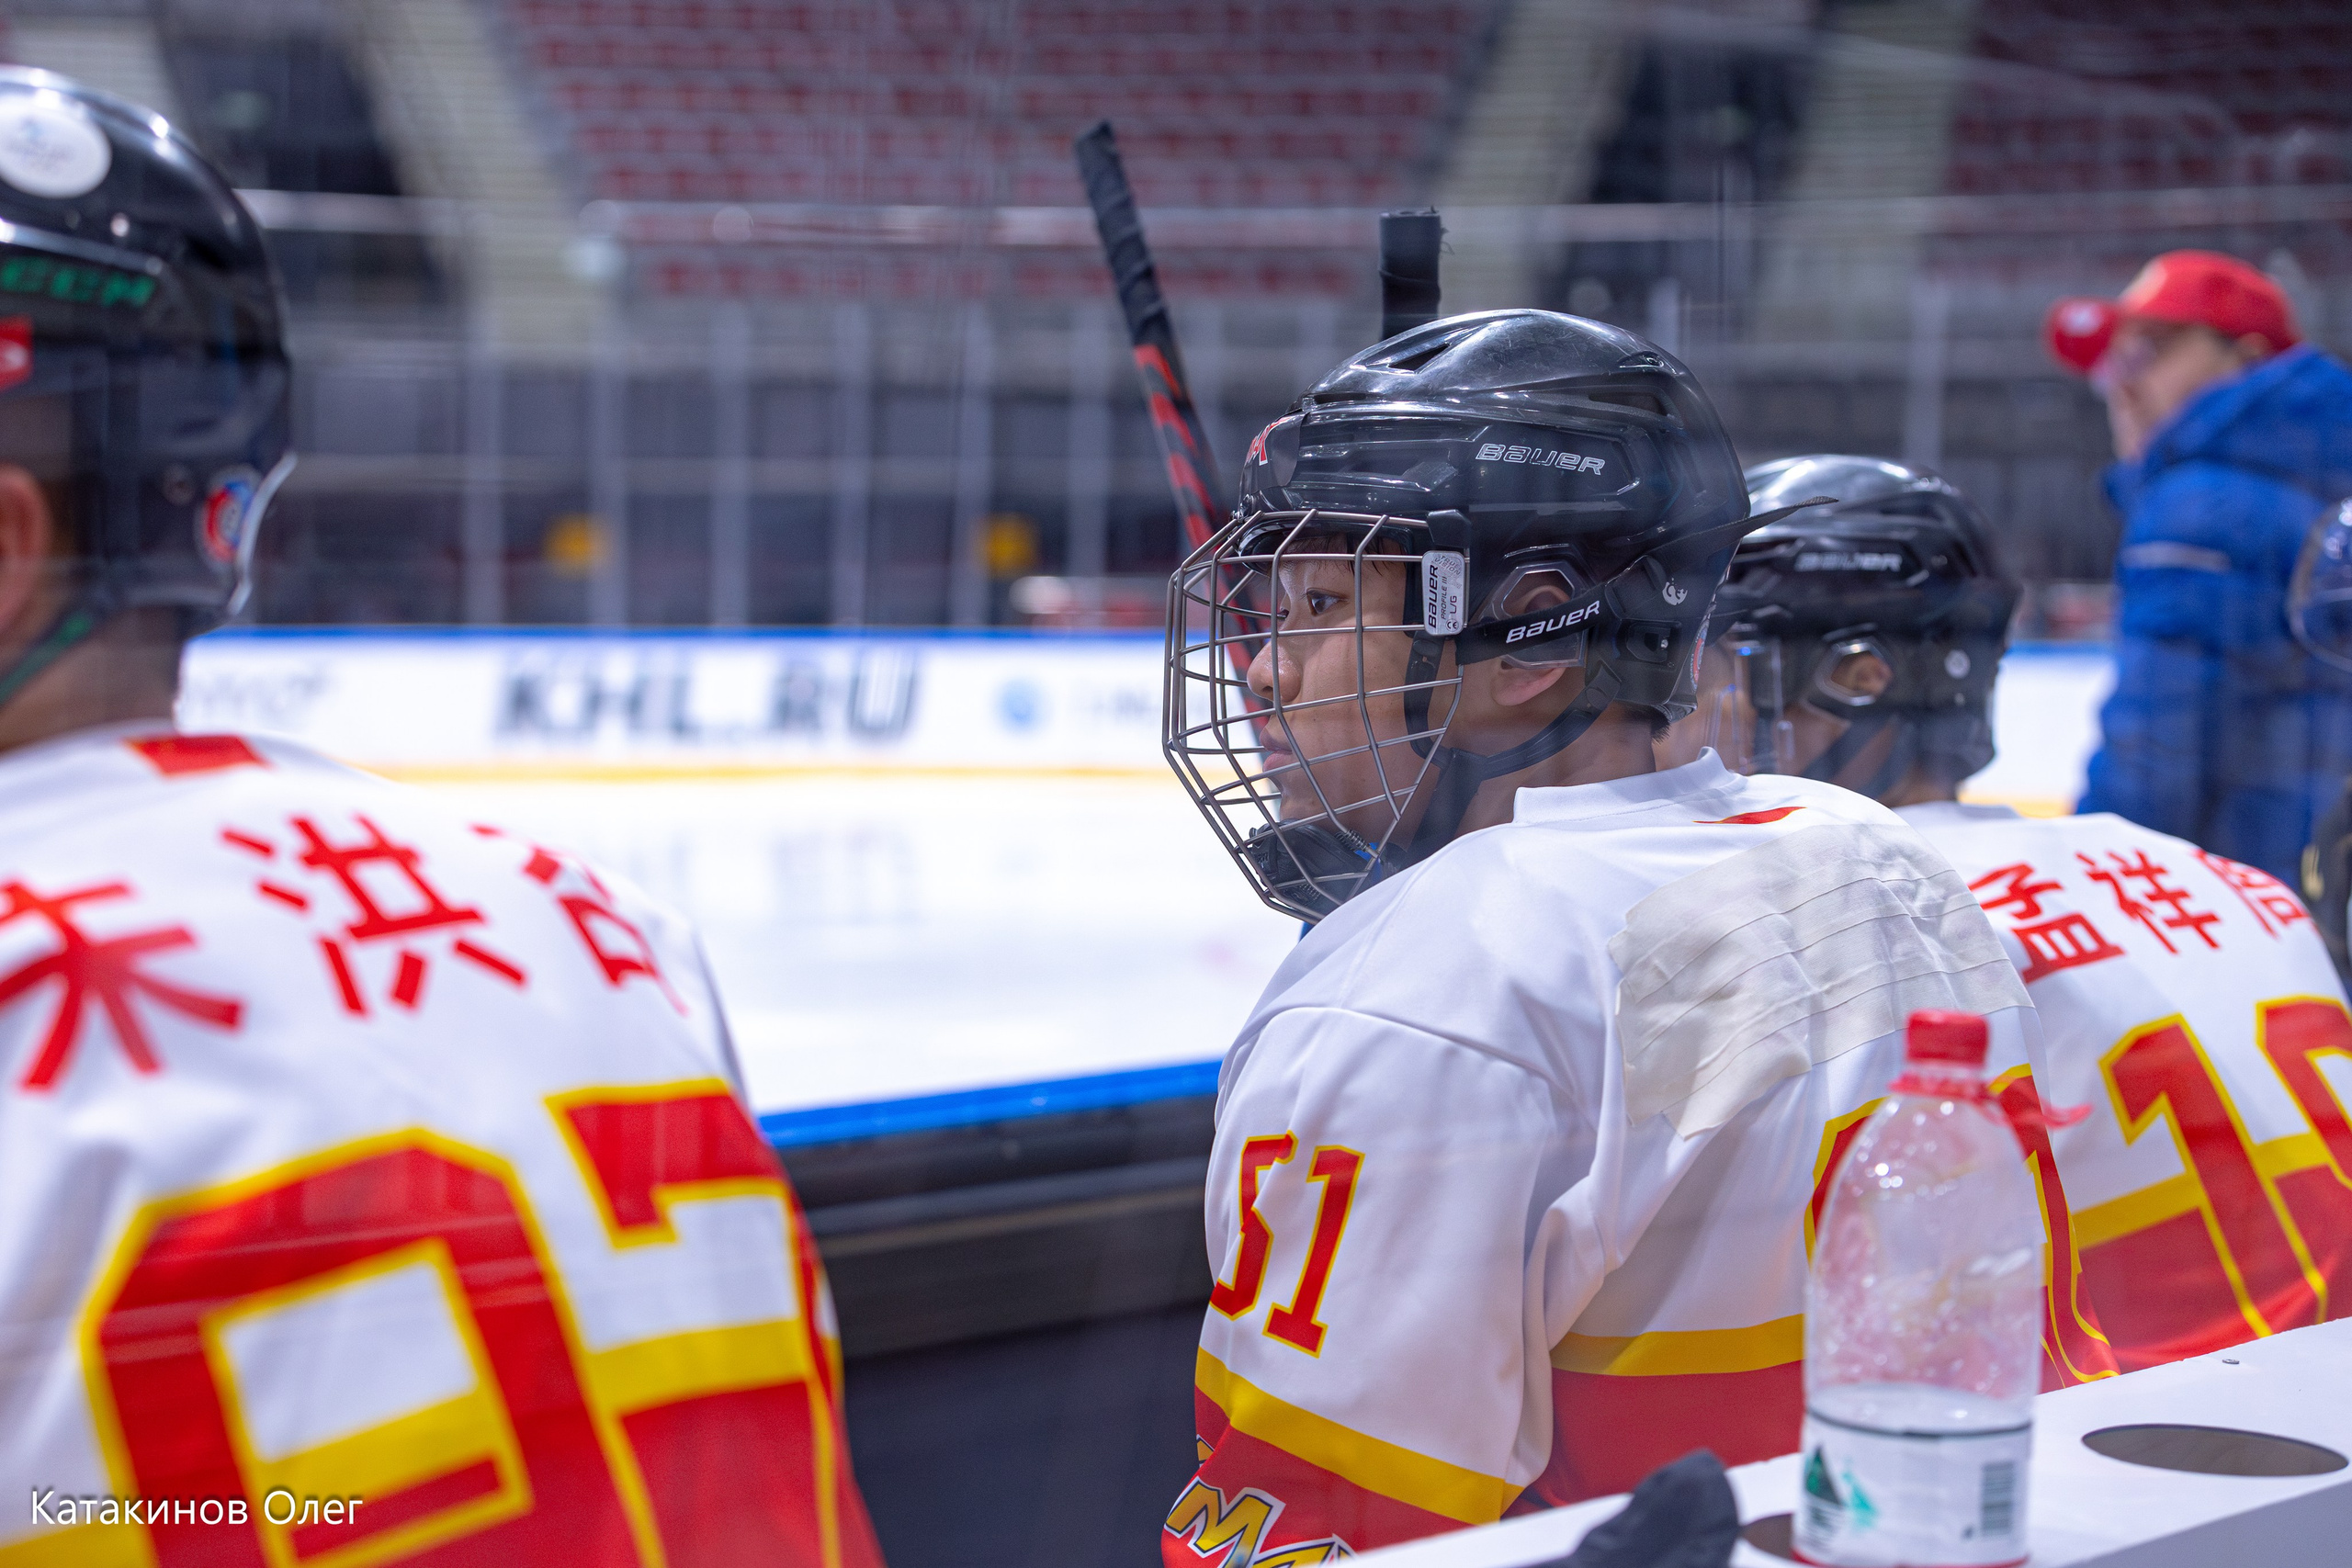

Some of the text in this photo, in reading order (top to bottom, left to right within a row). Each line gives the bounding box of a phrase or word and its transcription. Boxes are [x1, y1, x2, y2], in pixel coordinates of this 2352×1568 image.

[1475, 443, 1606, 476] BAUER
[1428, 564, 1439, 629] BAUER
[1505, 600, 1600, 644] BAUER
